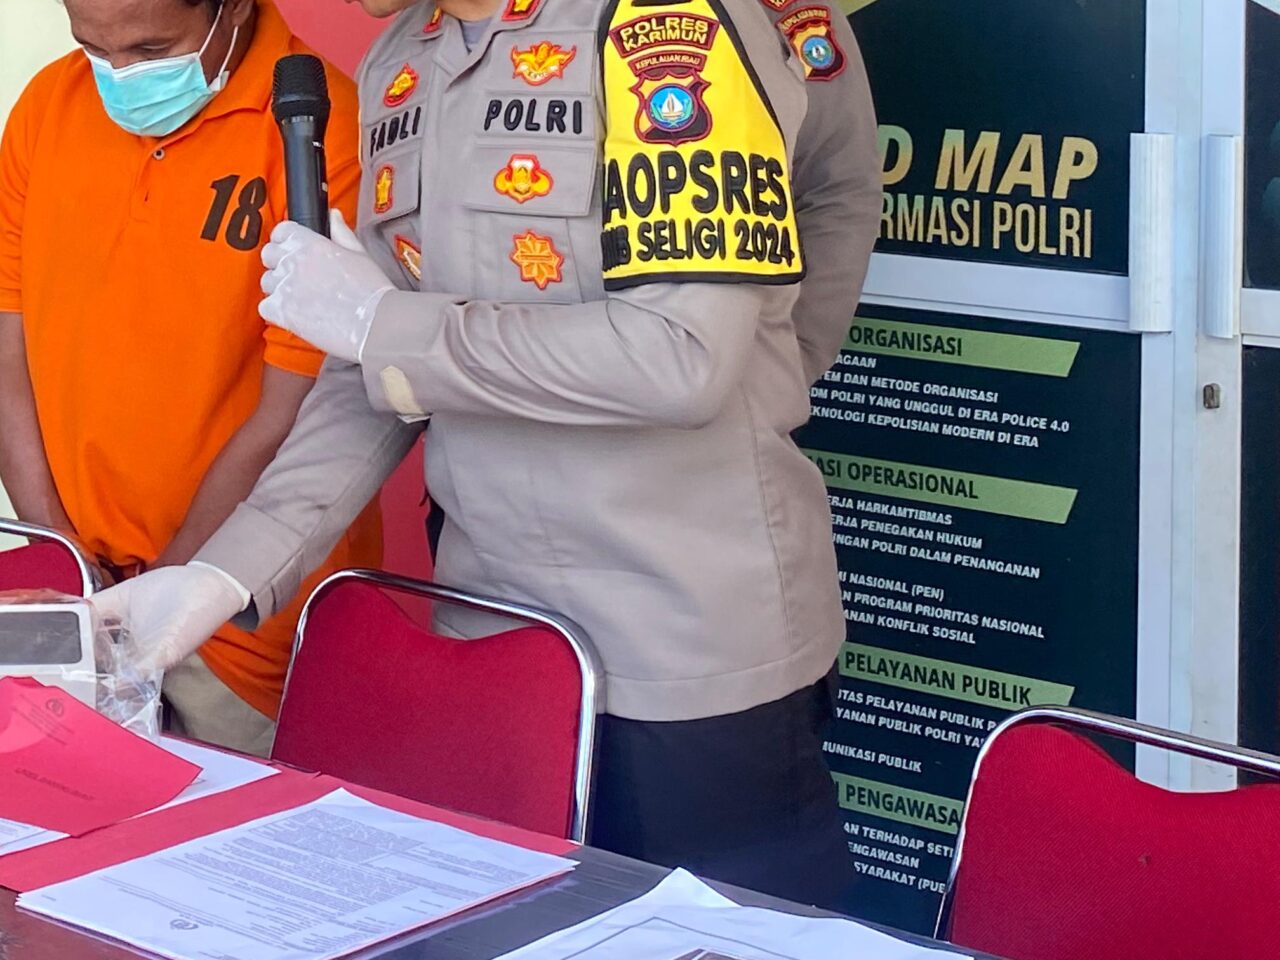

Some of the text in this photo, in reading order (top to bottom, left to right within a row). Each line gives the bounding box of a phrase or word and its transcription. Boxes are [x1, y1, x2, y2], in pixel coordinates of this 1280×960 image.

[621, 17, 708, 40] POLRES
[624, 29, 706, 51] KARIMUN
[483, 98, 582, 135] POLRI
[934, 128, 1098, 200] MAP
[200, 174, 267, 251] 18
[992, 201, 1092, 258] POLRI
[635, 218, 726, 261] SELIGI
[735, 220, 795, 267] 2024
[849, 325, 962, 357] ORGANISASI
[843, 373, 868, 385] DAN
[871, 376, 920, 392] METODE
[923, 383, 998, 403] ORGANISASI
[831, 390, 865, 404] POLRI
[868, 394, 900, 409] YANG
[904, 400, 955, 417] UNGGUL
[958, 407, 971, 418] DI
[973, 409, 998, 422] ERA
[1001, 413, 1047, 429] POLICE
[1050, 420, 1070, 432] 4.0
[867, 414, 939, 433] KEPOLISIAN
[942, 424, 995, 441] MODERN
[997, 431, 1011, 443] DI
[1013, 434, 1039, 448] ERA
[847, 461, 979, 500] OPERASIONAL
[856, 500, 953, 525] HARKAMTIBMAS
[861, 519, 933, 541] PENEGAKAN
[936, 532, 982, 549] HUKUM
[871, 540, 907, 555] POLRI
[909, 547, 951, 564] DALAM
[953, 554, 1040, 579] PENANGANAN
[849, 573, 908, 593] NASIONAL
[911, 584, 944, 602] (PEN)
[854, 592, 913, 613] PROGRAM
[915, 604, 978, 625] PRIORITAS
[981, 616, 1045, 639] NASIONAL
[877, 616, 929, 635] KONFLIK
[932, 626, 976, 644] SOSIAL
[845, 651, 1031, 706] PELAYANAN PUBLIK
[865, 695, 937, 719] PELAYANAN
[940, 710, 984, 730] PUBLIK
[878, 716, 922, 735] PUBLIK
[924, 727, 961, 744] POLRI
[878, 753, 922, 772] PUBLIK
[862, 826, 925, 850] TERHADAP
